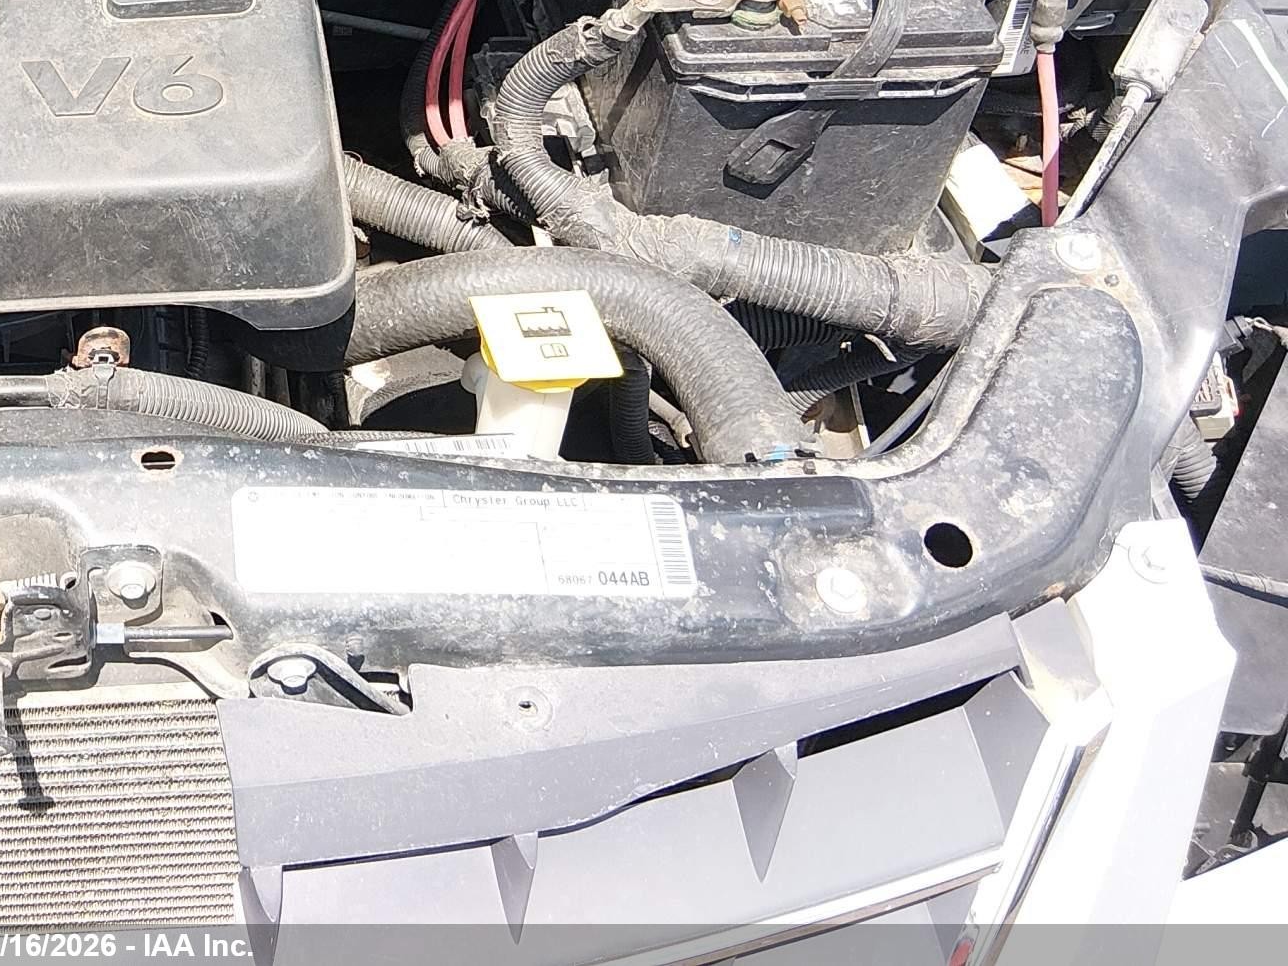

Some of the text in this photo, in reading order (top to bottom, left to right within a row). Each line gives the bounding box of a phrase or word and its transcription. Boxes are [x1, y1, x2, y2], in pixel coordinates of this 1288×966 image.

[21, 54, 225, 118] V6
[452, 494, 579, 509] Chrysler Group LLC
[598, 571, 650, 586] 044AB
